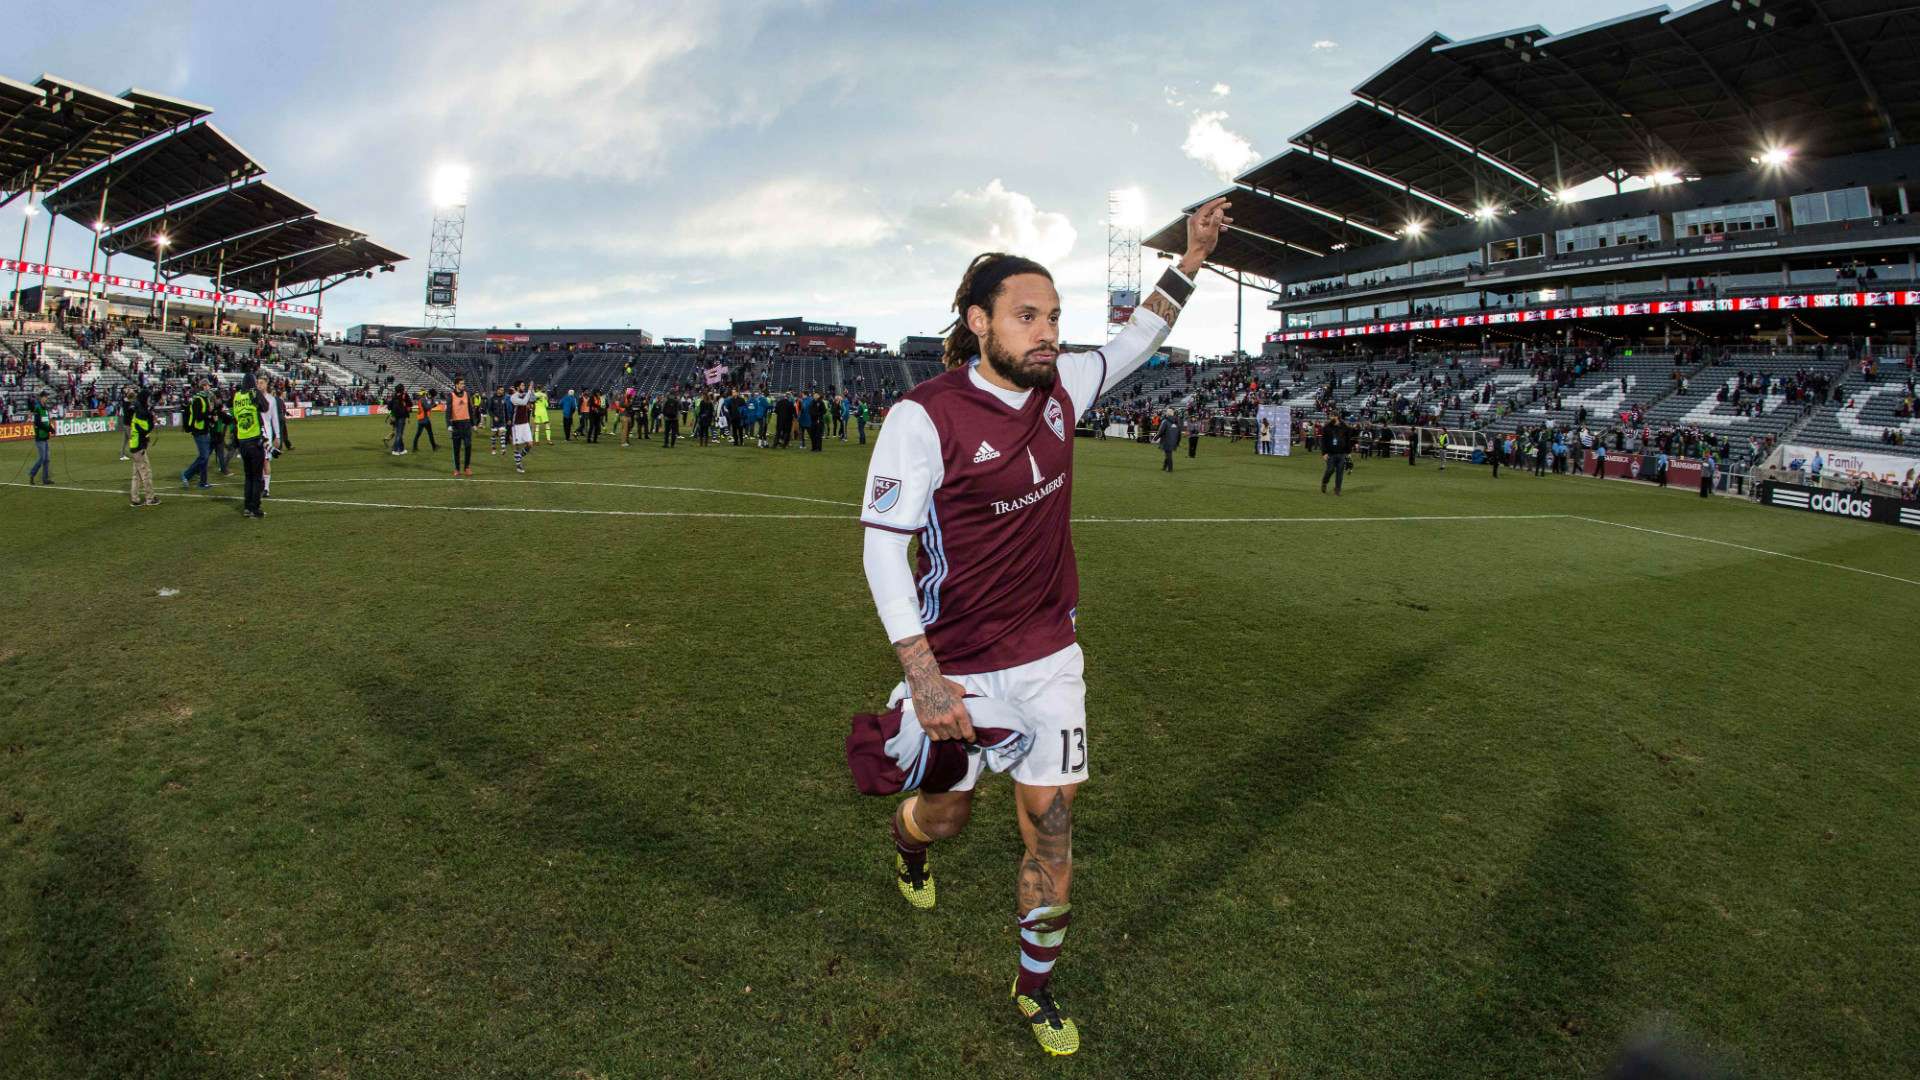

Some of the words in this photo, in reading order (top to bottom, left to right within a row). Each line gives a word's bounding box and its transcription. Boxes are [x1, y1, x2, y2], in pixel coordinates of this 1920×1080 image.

[1692, 300, 1715, 312] SINCE
[1814, 295, 1838, 307] SINCE
[1840, 294, 1857, 306] 1876
[1583, 306, 1602, 318] SINCE
[0, 425, 21, 437] ELLS
[55, 417, 106, 436] Heineken
[973, 450, 1001, 463] adidas
[1827, 453, 1864, 472] Family
[1671, 459, 1701, 471] TRANSAMER
[876, 479, 890, 490] MLS
[991, 472, 1066, 515] TRANSAMERIC
[1811, 491, 1872, 519] adidas
[1060, 727, 1086, 775] 13
